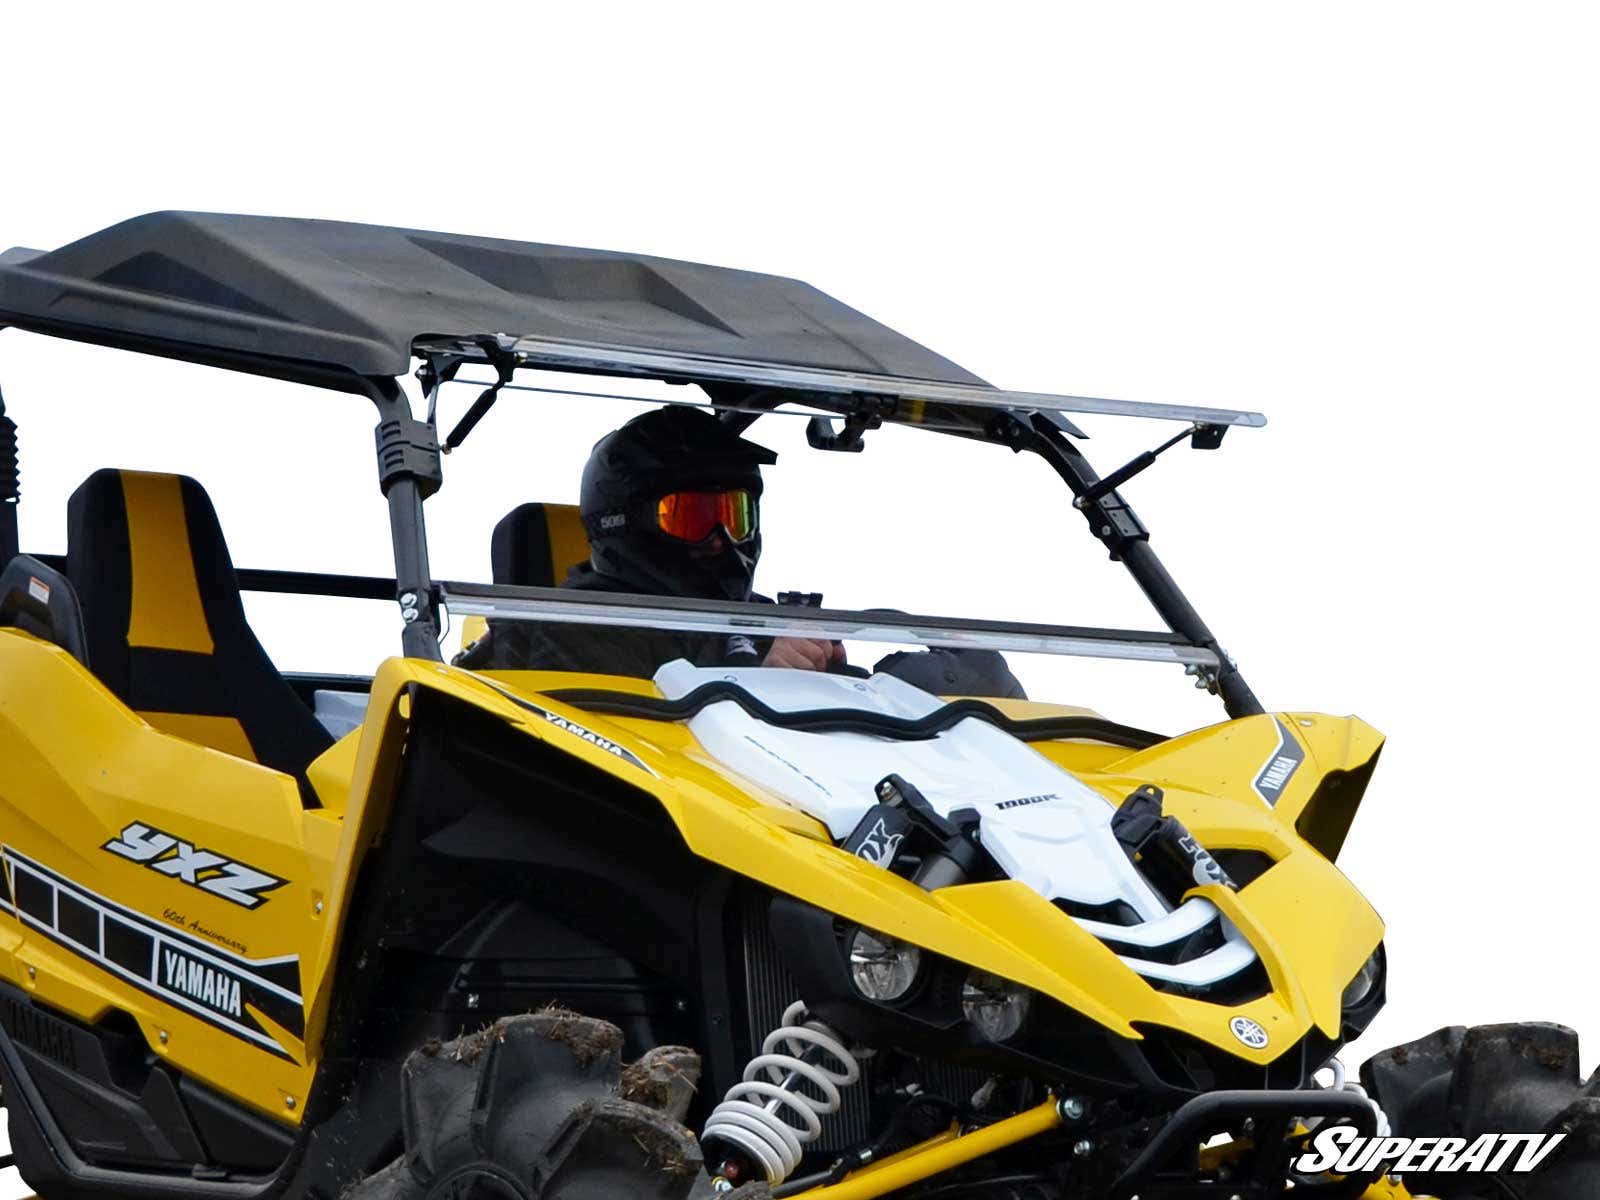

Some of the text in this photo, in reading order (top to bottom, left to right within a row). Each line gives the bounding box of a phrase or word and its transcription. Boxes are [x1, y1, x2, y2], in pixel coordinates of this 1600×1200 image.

[545, 711, 623, 756] YAMAHA
[1258, 756, 1298, 791] YAMAHA
[102, 821, 287, 909] YXZ
[855, 817, 904, 870] OX
[162, 908, 248, 954] 60th Anniversary
[165, 950, 242, 1017] YAMAHA
